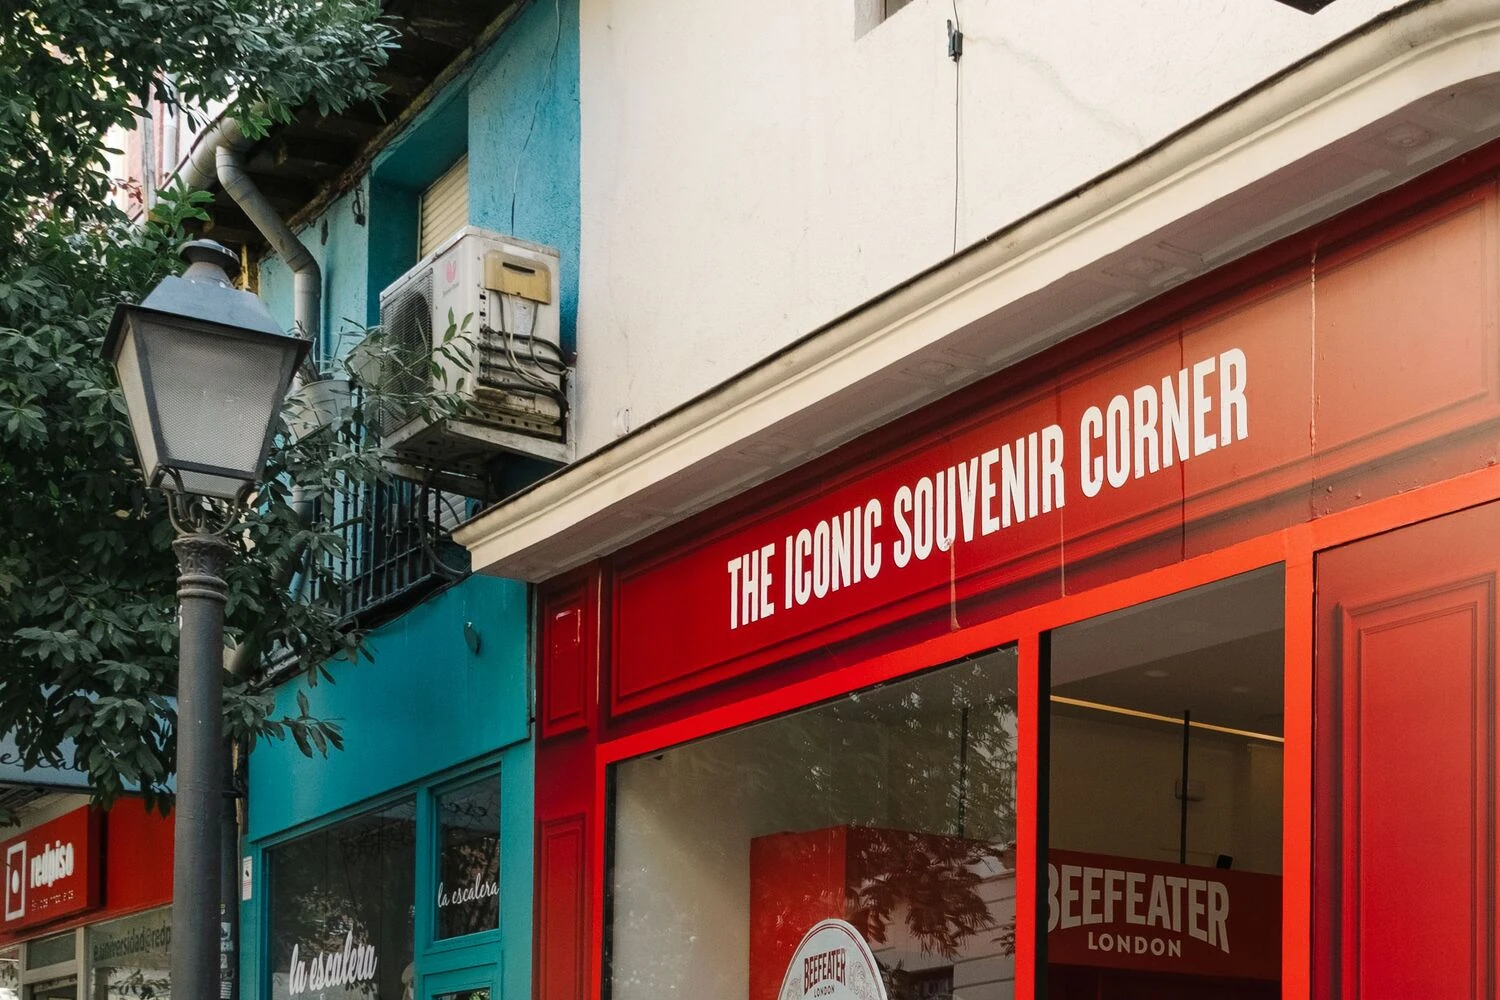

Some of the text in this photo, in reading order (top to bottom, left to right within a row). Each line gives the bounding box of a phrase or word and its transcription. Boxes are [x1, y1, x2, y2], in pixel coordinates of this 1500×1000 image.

[727, 347, 1249, 631] THE ICONIC SOUVENIR CORNER
[30, 840, 74, 889] redpiso
[437, 872, 500, 909] la escalera
[1047, 862, 1230, 954] BEEFEATER
[289, 929, 378, 997] la escalera
[1088, 931, 1182, 958] LONDON
[803, 947, 847, 996] BEEFEATER
[813, 984, 836, 998] LONDON
